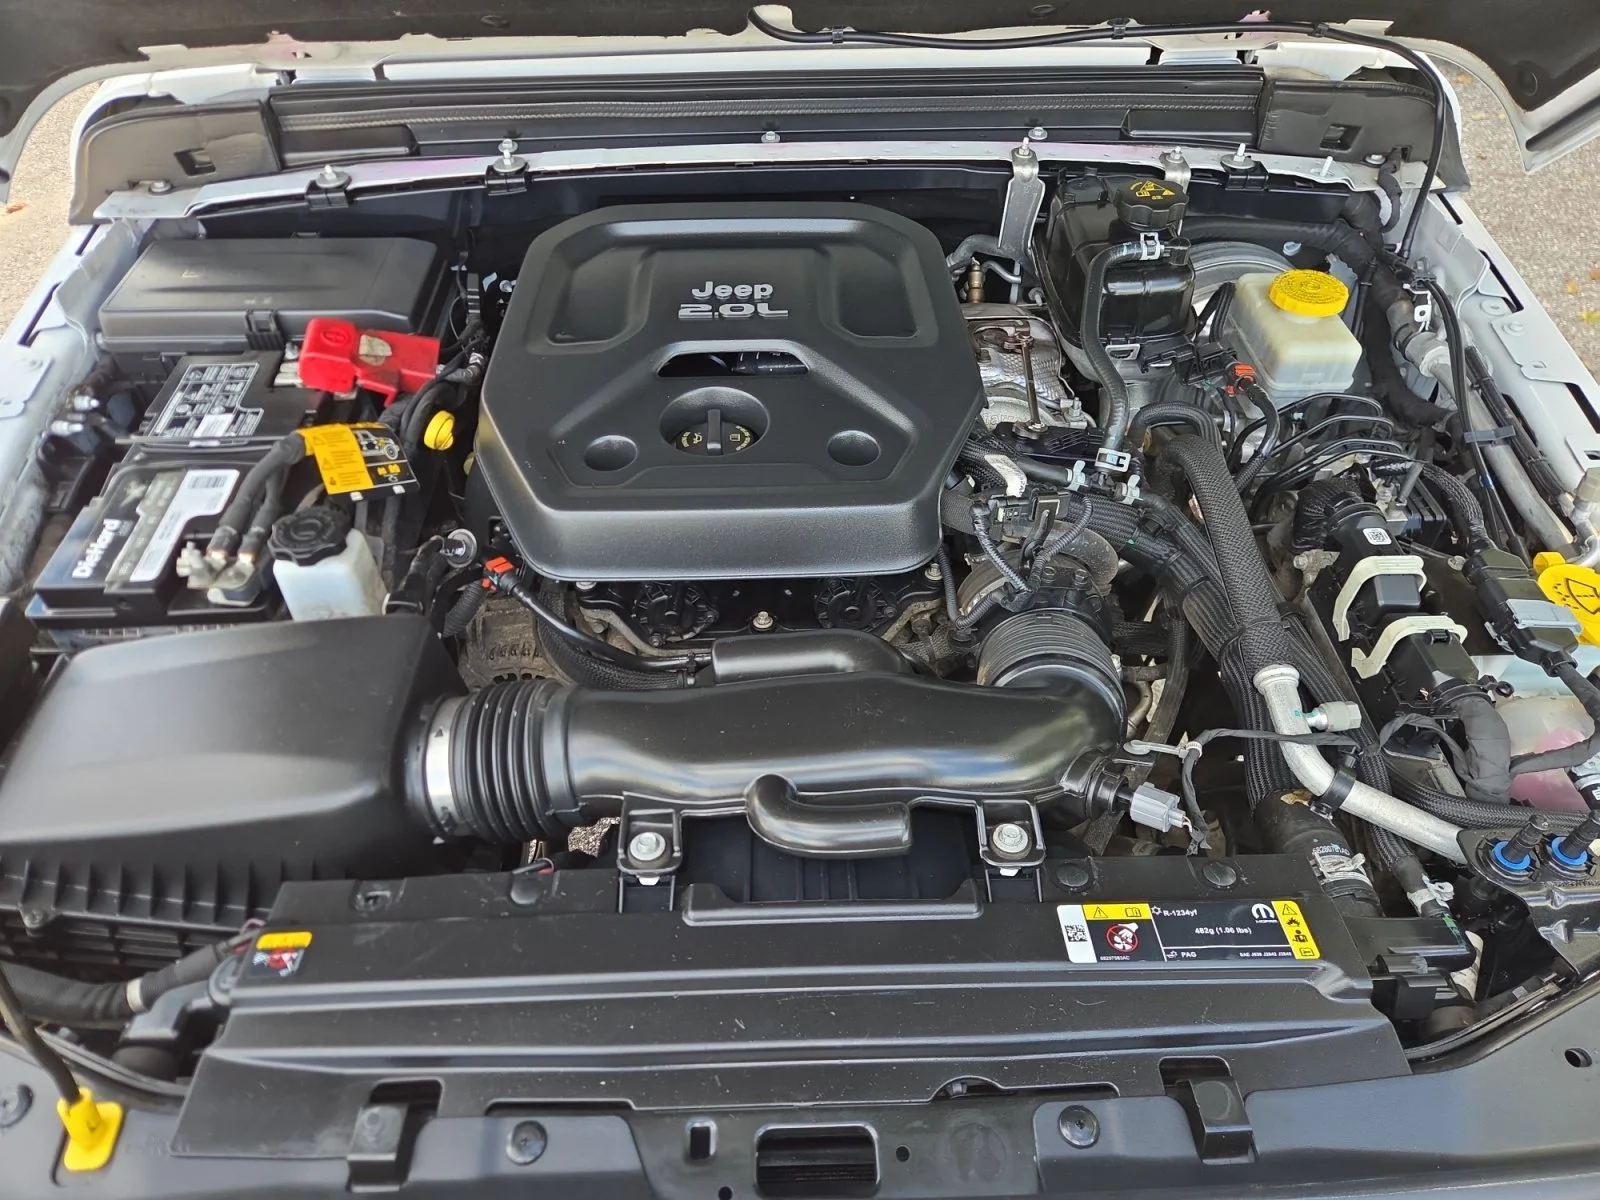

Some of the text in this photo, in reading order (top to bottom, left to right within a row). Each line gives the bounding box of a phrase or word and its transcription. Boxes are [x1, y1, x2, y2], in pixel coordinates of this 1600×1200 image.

[691, 281, 774, 302] Jeep
[678, 303, 789, 319] 2.0L
[71, 518, 122, 579] DieHard
